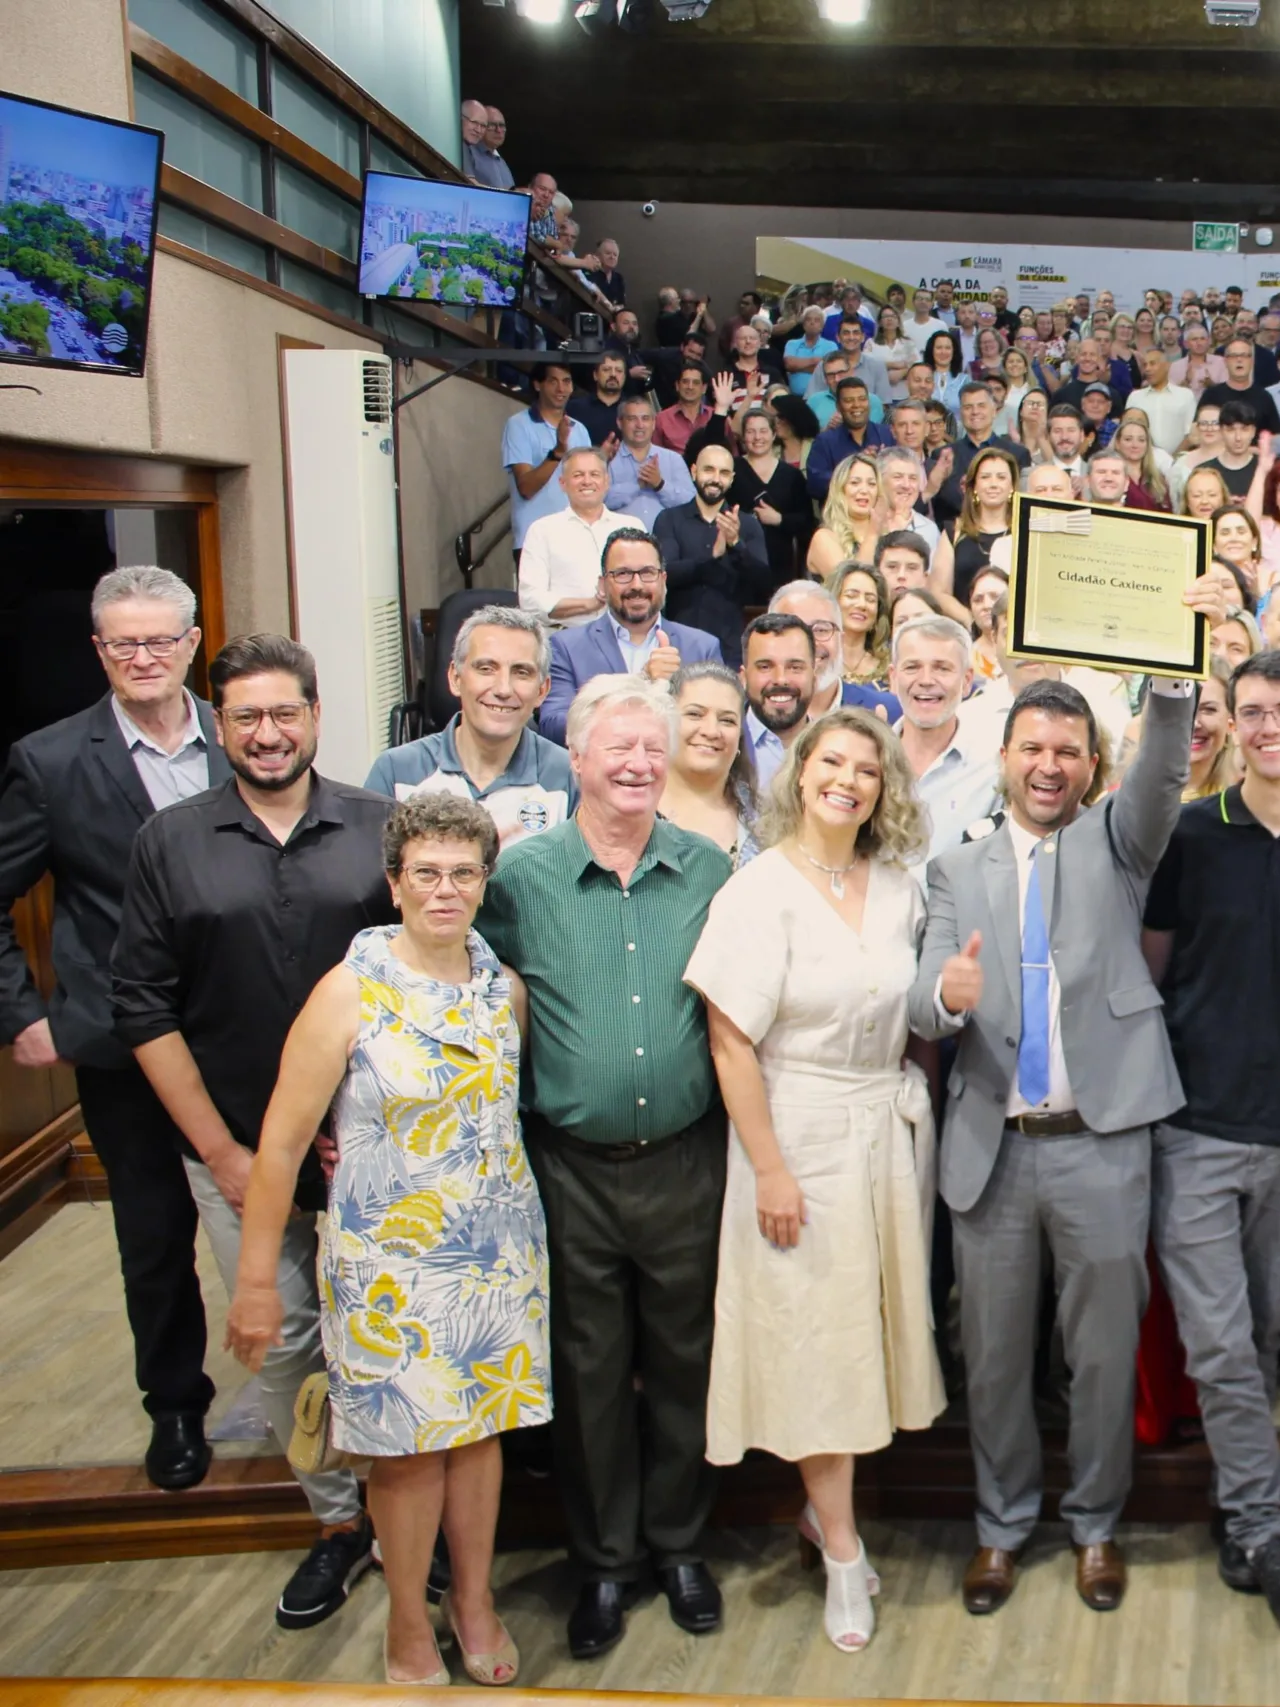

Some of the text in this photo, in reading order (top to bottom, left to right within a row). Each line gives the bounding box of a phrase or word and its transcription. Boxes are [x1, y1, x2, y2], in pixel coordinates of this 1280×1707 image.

[1196, 224, 1235, 241] SAÍDA
[1020, 265, 1054, 275] FUNÇÕES
[919, 278, 981, 290] A CA DA
[1032, 274, 1065, 282] CÂMARA
[1058, 570, 1106, 586] Cidadão
[1110, 577, 1163, 593] Caxiense
